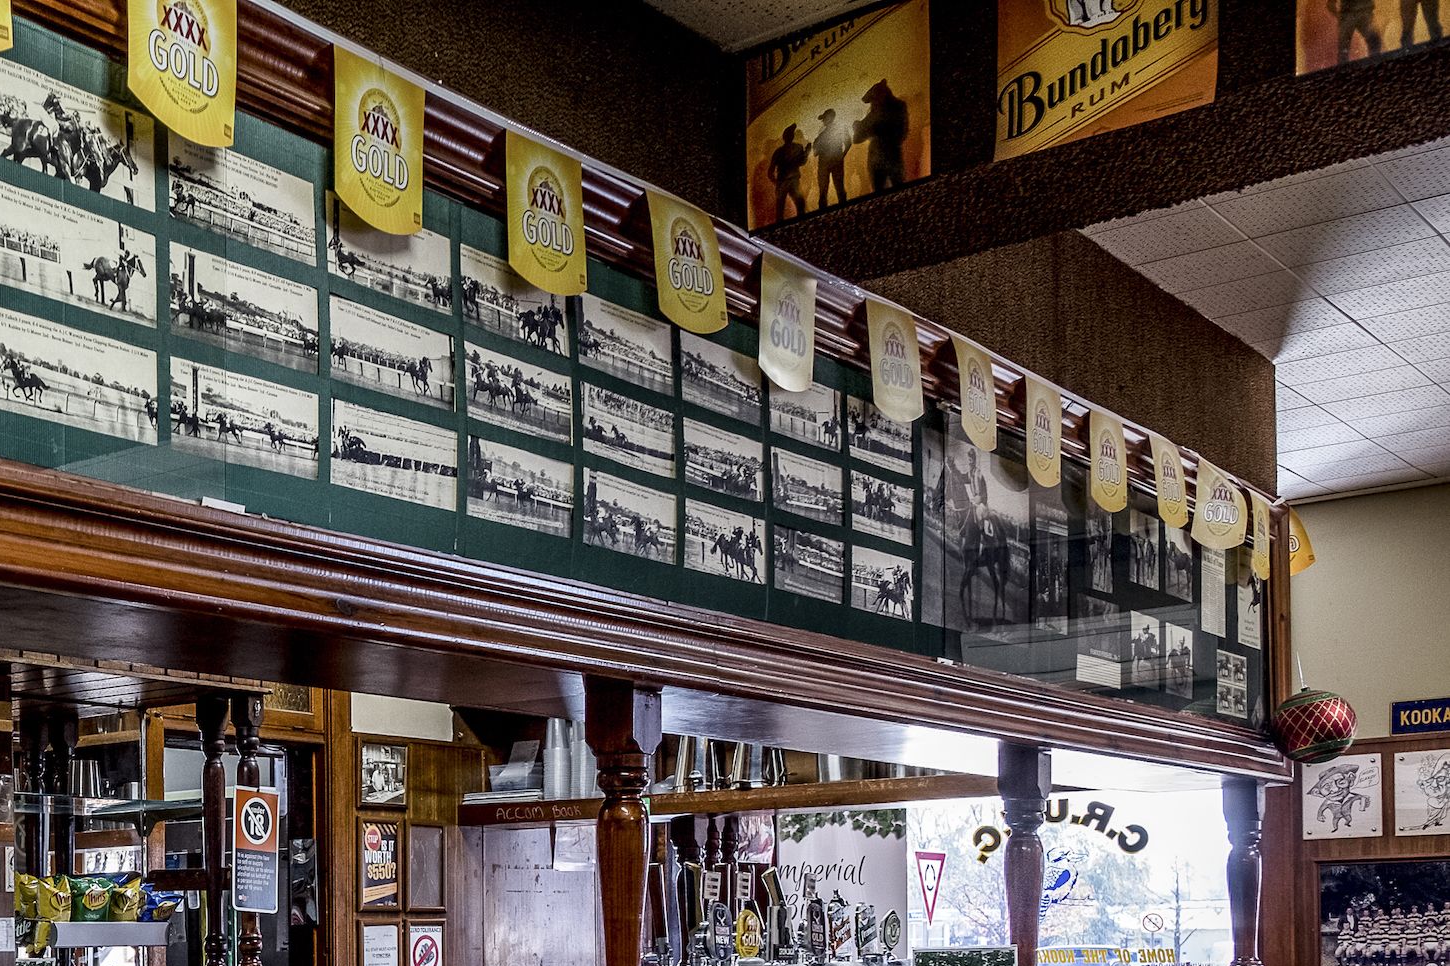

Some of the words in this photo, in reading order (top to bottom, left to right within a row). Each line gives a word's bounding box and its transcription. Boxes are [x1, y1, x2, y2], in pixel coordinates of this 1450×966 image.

[161, 5, 208, 52] XXXX
[808, 17, 857, 61] RUM
[148, 28, 219, 98] GOLD
[998, 0, 1209, 141] Bundaberg
[1070, 74, 1131, 120] RUM
[361, 111, 399, 149] XXXX
[350, 134, 408, 191] GOLD
[530, 187, 564, 218] XXXX
[521, 209, 574, 256] GOLD
[673, 237, 705, 262] XXXX
[667, 257, 714, 297] GOLD
[778, 300, 800, 324] XXXX
[770, 318, 807, 357] GOLD
[884, 340, 906, 360] XXXX
[879, 358, 914, 390] GOLD
[969, 374, 986, 393] XXXX
[966, 387, 991, 422] GOLD
[1035, 413, 1050, 432] XXXX
[1032, 428, 1055, 459] GOLD
[1101, 444, 1118, 461] XXXX
[1097, 459, 1121, 485] GOLD
[1163, 466, 1177, 480] XXXX
[1161, 478, 1182, 502] GOLD
[1211, 487, 1234, 503] XXXX
[1204, 502, 1238, 525] GOLD
[496, 806, 544, 820] ACCOM
[552, 804, 582, 818] BOOK
[248, 814, 265, 836] 18
[366, 834, 379, 845] STOP
[380, 840, 387, 850] IS
[388, 840, 394, 850] IT
[364, 850, 392, 864] WORTH
[367, 862, 396, 880] $550?
[779, 855, 867, 892] mperial
[88, 892, 106, 904] Thins
[716, 936, 729, 945] NEW
